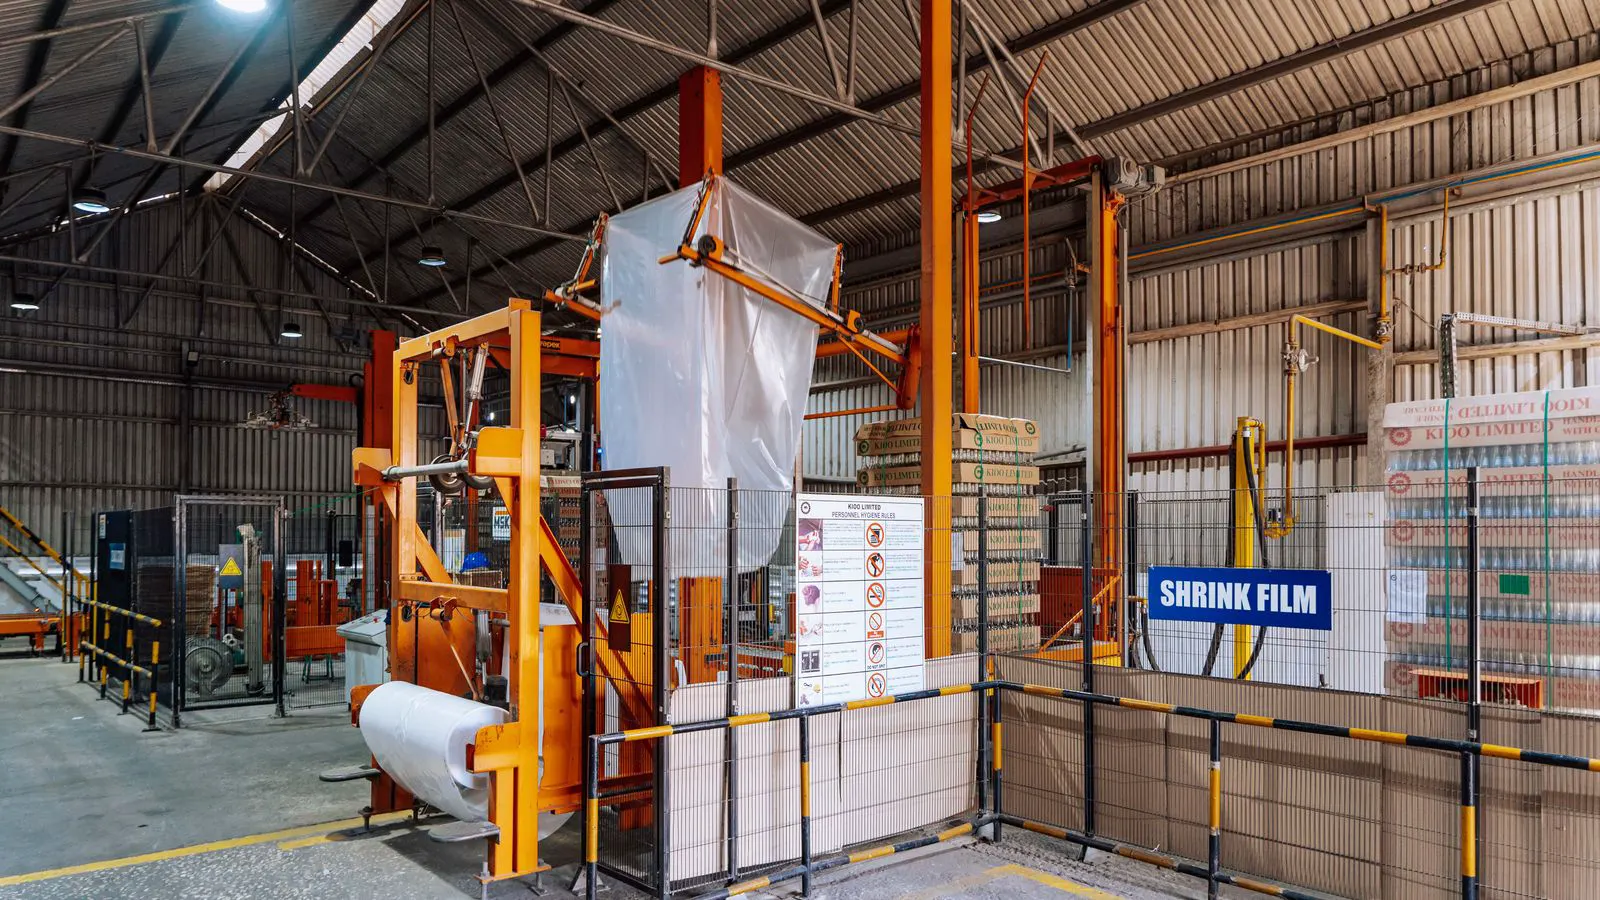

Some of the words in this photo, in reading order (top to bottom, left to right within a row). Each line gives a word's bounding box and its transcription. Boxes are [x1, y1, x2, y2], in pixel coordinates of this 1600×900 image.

[1458, 402, 1535, 418] LIMITED
[1563, 416, 1600, 424] HANDL
[1425, 426, 1470, 440] KIOO
[1475, 420, 1554, 437] LIMITED
[1483, 472, 1554, 487] IMITED
[1563, 470, 1600, 478] HANDL
[494, 516, 510, 529] MSK
[1160, 579, 1252, 611] SHRINK
[1257, 583, 1317, 615] FILM
